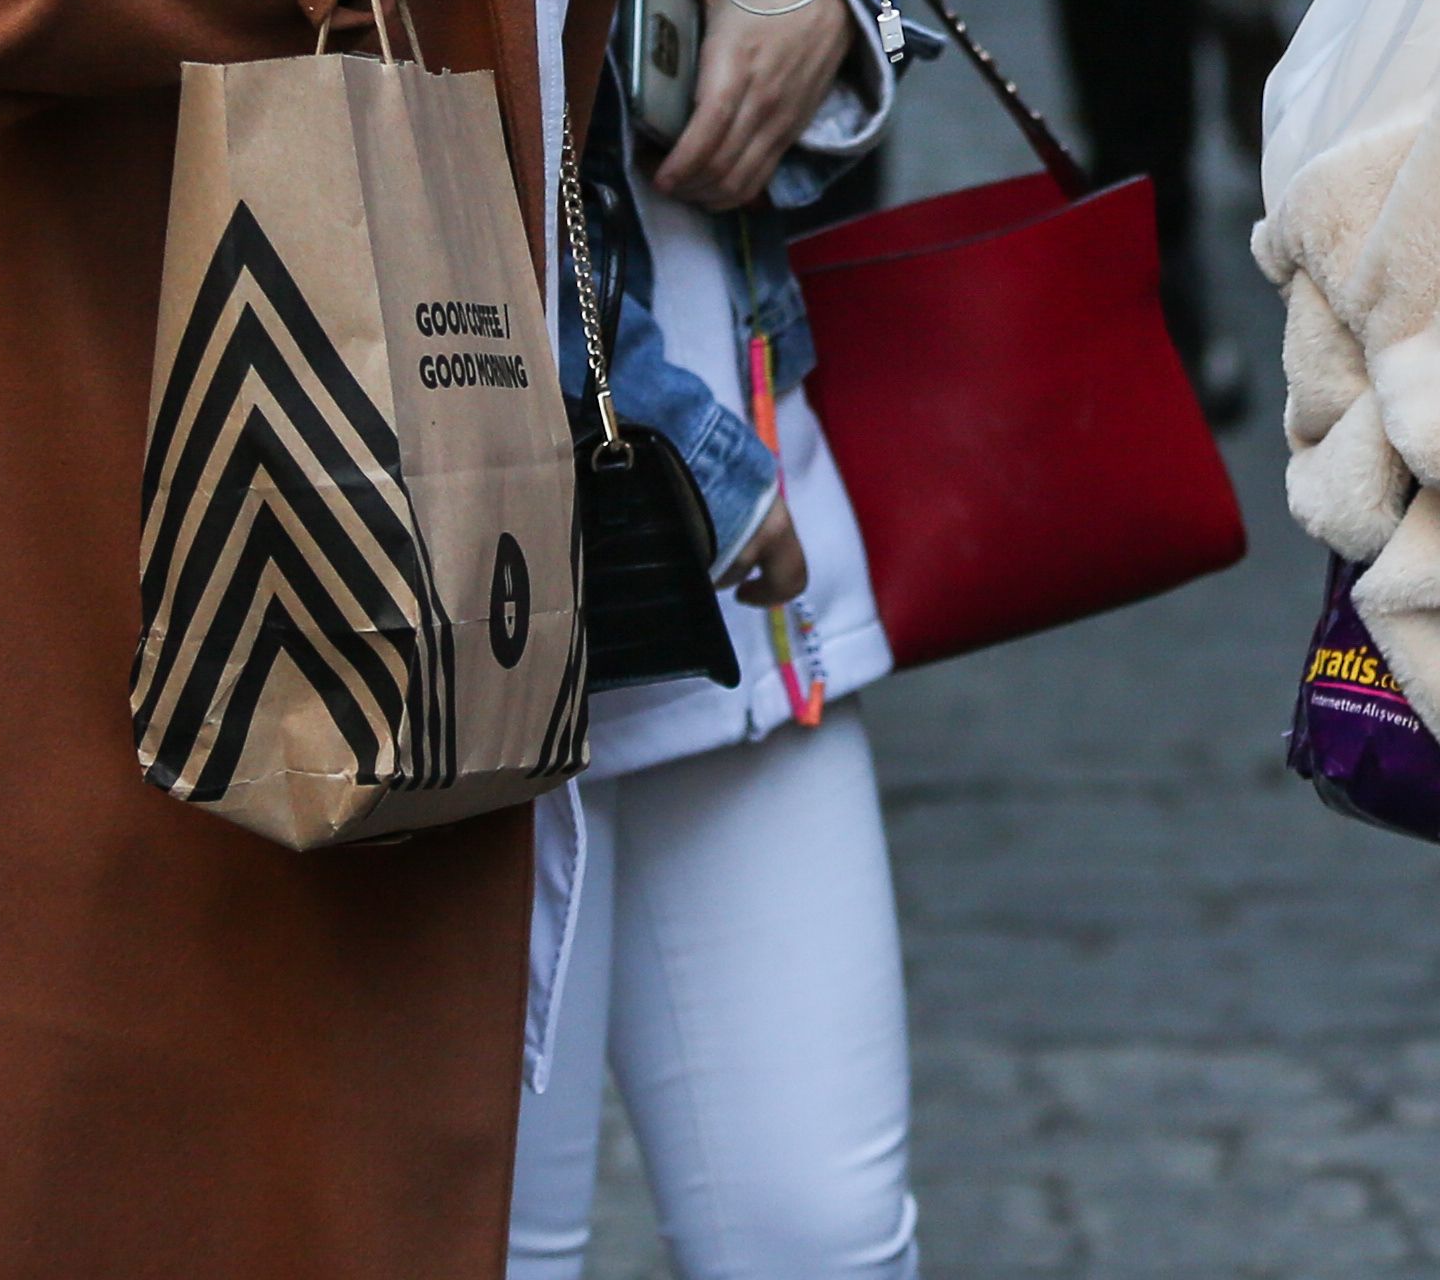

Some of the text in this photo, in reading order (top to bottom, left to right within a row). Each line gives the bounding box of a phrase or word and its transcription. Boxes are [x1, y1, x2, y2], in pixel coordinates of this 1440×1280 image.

[416, 301, 468, 337] GOOD
[465, 303, 504, 338] COFFEE
[419, 353, 528, 389] GOOD MORNING
